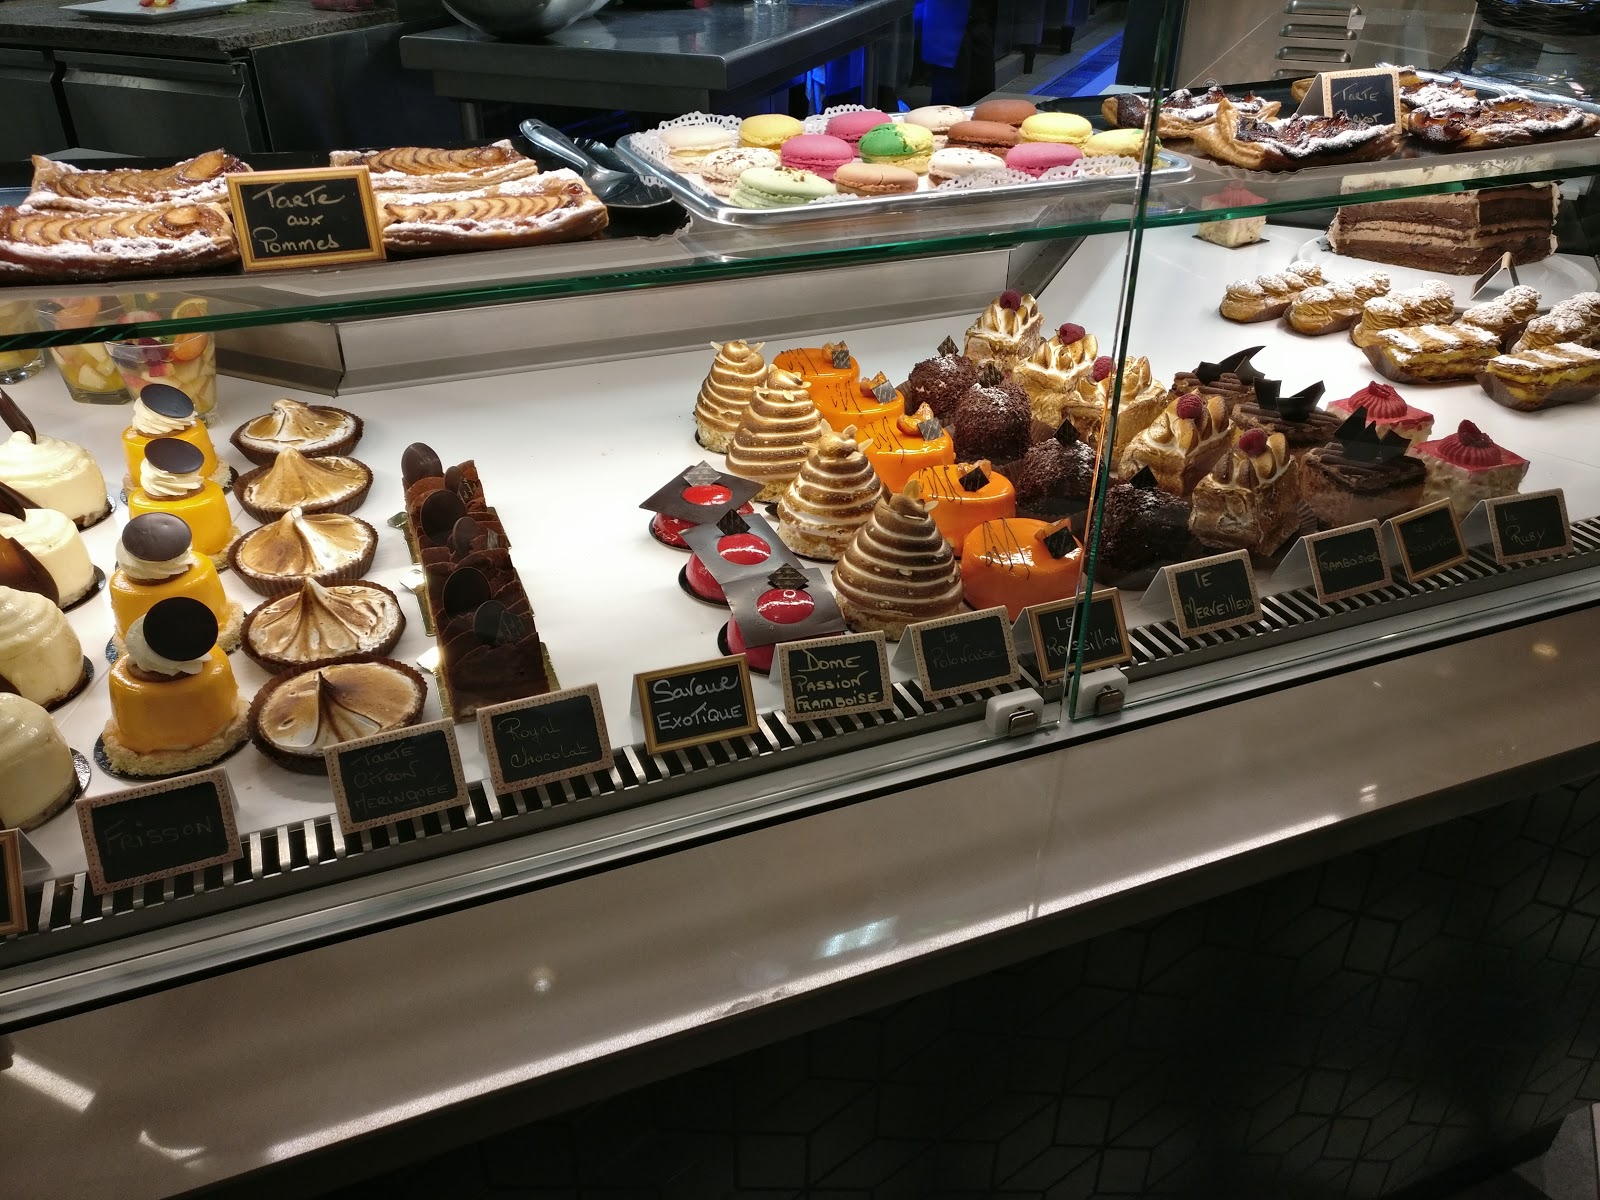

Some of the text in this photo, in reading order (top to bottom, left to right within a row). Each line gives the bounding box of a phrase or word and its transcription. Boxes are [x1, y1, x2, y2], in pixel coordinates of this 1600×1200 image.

[286, 214, 324, 227] aux
[252, 226, 340, 253] Pommes
[797, 649, 861, 672] DOME
[792, 670, 868, 692] PASSION
[795, 690, 879, 711] FRAMBOISE
[657, 701, 742, 731] EXOTIQUE
[510, 742, 592, 768] Chocolat
